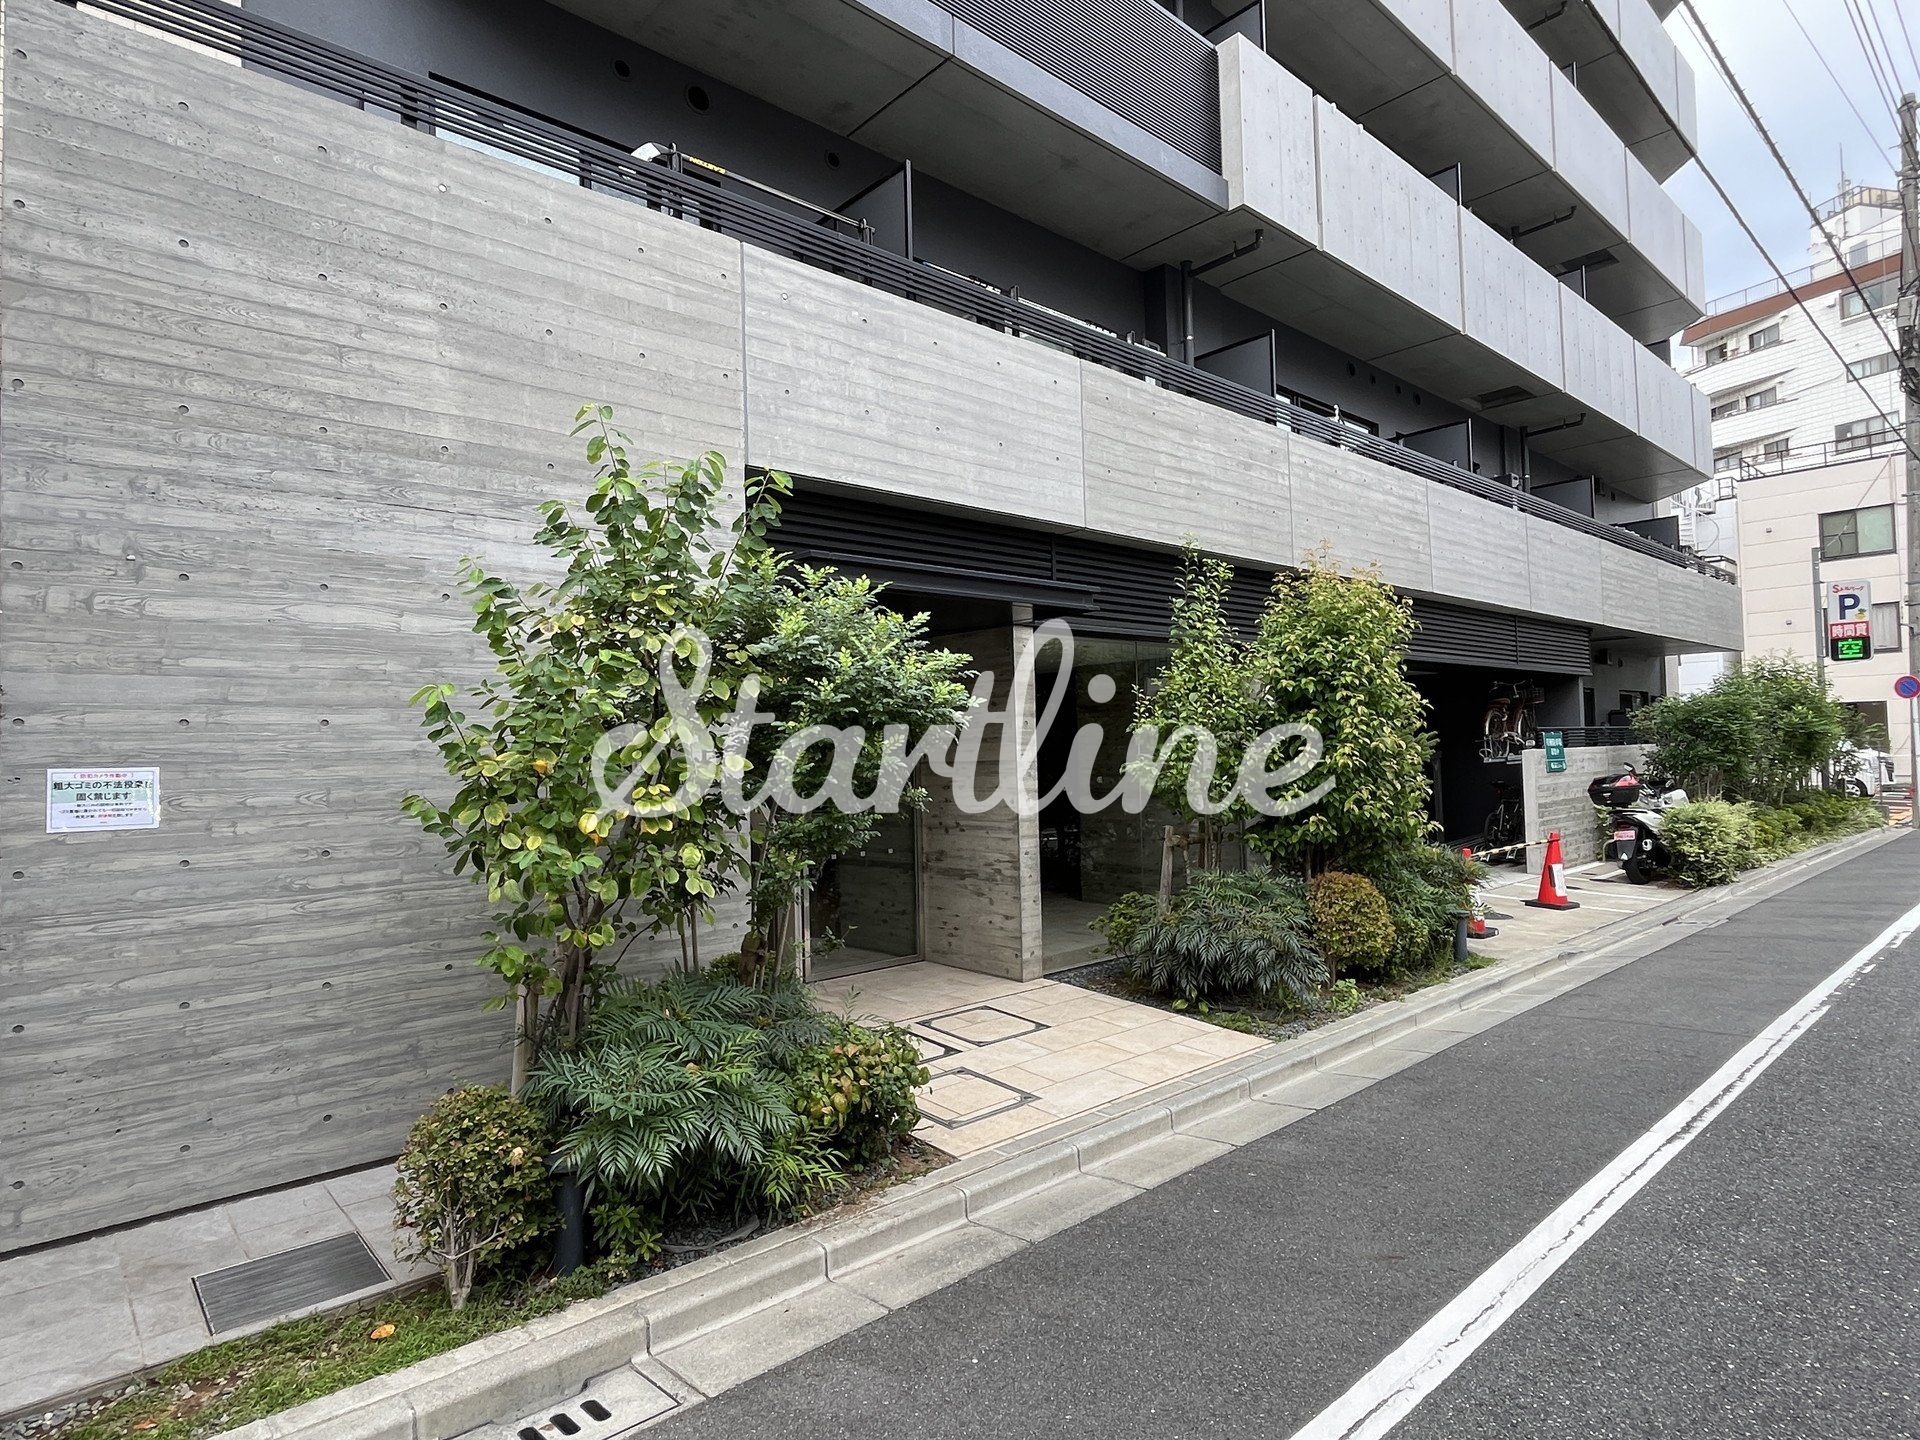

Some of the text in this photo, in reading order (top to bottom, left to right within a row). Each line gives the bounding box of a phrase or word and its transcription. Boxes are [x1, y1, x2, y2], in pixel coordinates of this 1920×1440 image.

[1838, 593, 1860, 620] P
[1831, 623, 1867, 637] 時間貸
[1838, 638, 1862, 659] 空
[75, 792, 131, 801] 固く禁じます
